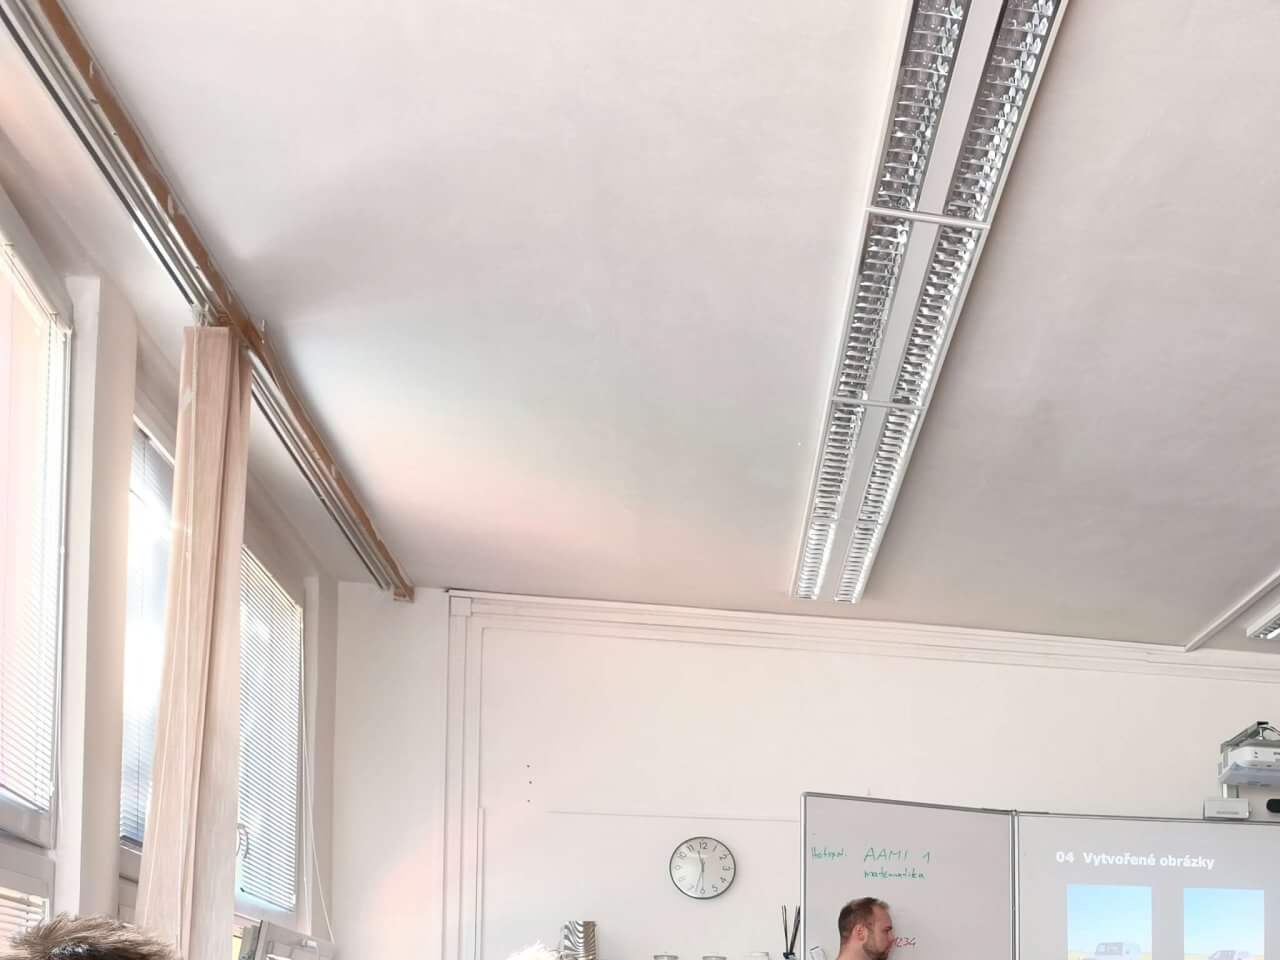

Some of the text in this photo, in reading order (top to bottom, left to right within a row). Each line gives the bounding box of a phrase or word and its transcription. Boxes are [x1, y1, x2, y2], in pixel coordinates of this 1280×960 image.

[699, 841, 708, 850] 12
[1056, 851, 1215, 870] 04 Vytvořené obrázky
